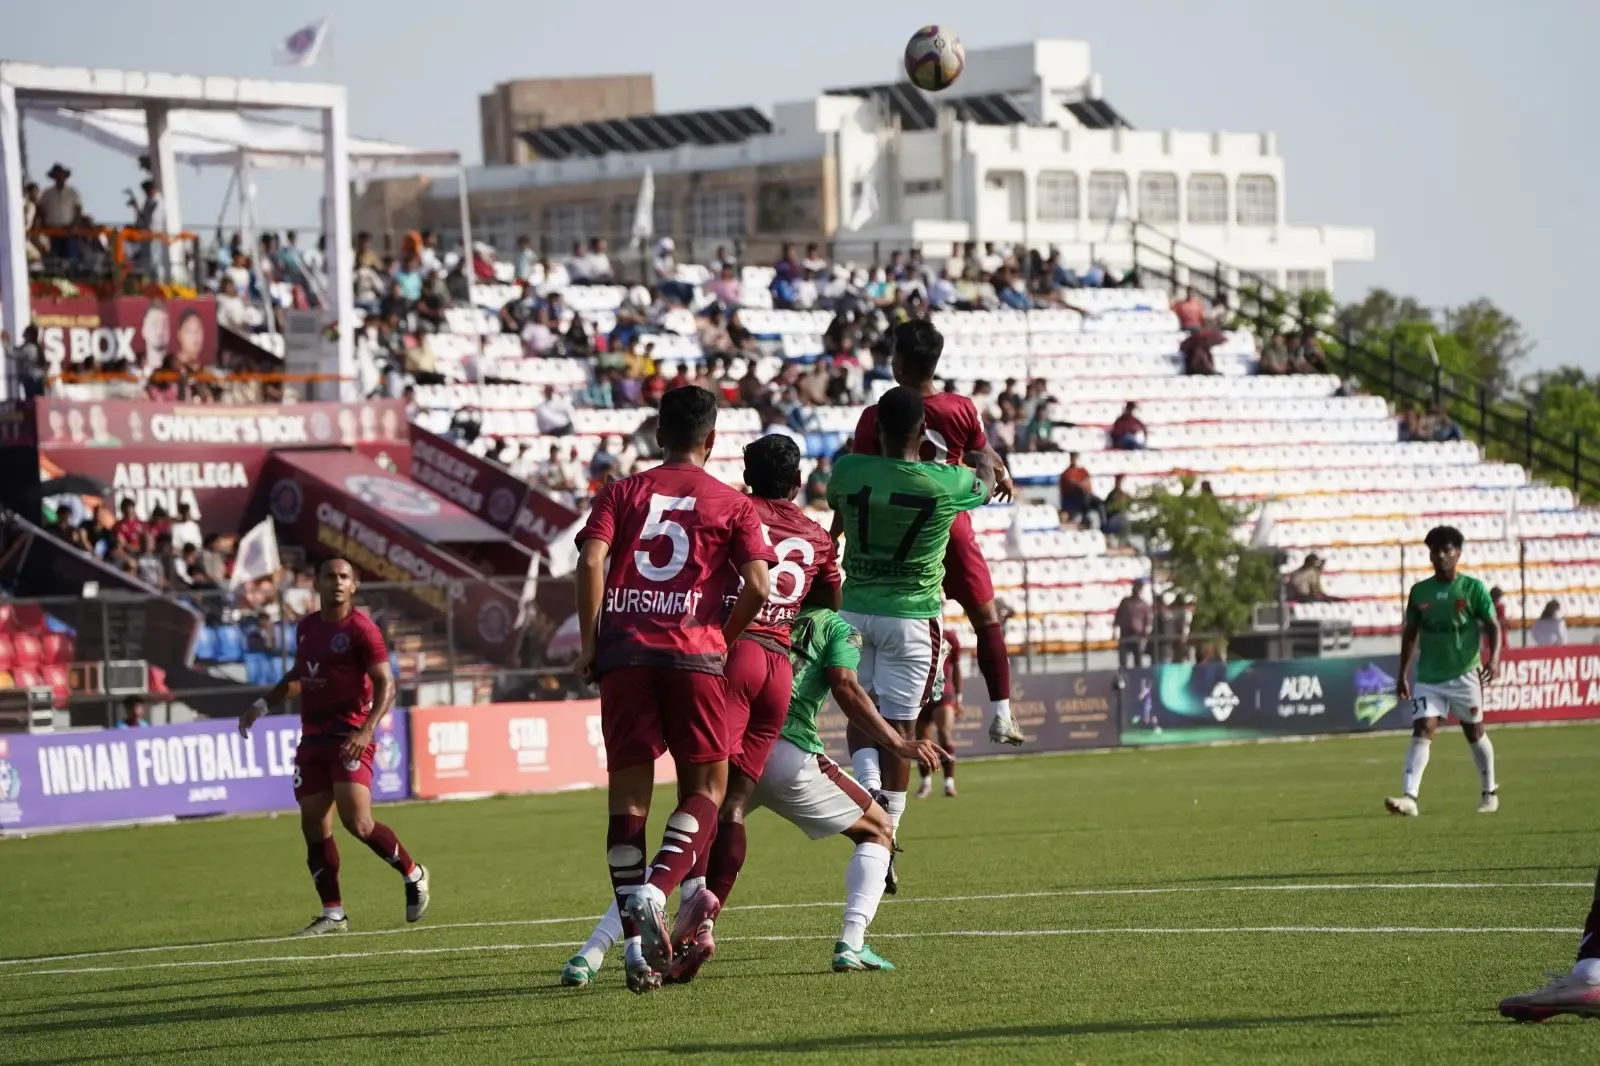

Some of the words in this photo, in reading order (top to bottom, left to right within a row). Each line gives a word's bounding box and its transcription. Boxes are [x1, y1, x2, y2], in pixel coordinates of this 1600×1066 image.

[70, 327, 136, 364] BOX
[151, 414, 258, 443] OWNER'S
[259, 413, 308, 443] BOX
[113, 462, 146, 488] AB
[148, 461, 248, 488] KHELEGA
[634, 493, 697, 582] 5
[846, 485, 938, 563] 17
[1491, 655, 1577, 685] JASTHAN
[1279, 674, 1323, 701] AURA
[1482, 681, 1583, 711] ESIDENTIAL
[38, 742, 131, 796] INDIAN
[136, 731, 264, 787] FOOTBALL
[266, 728, 302, 777] LE
